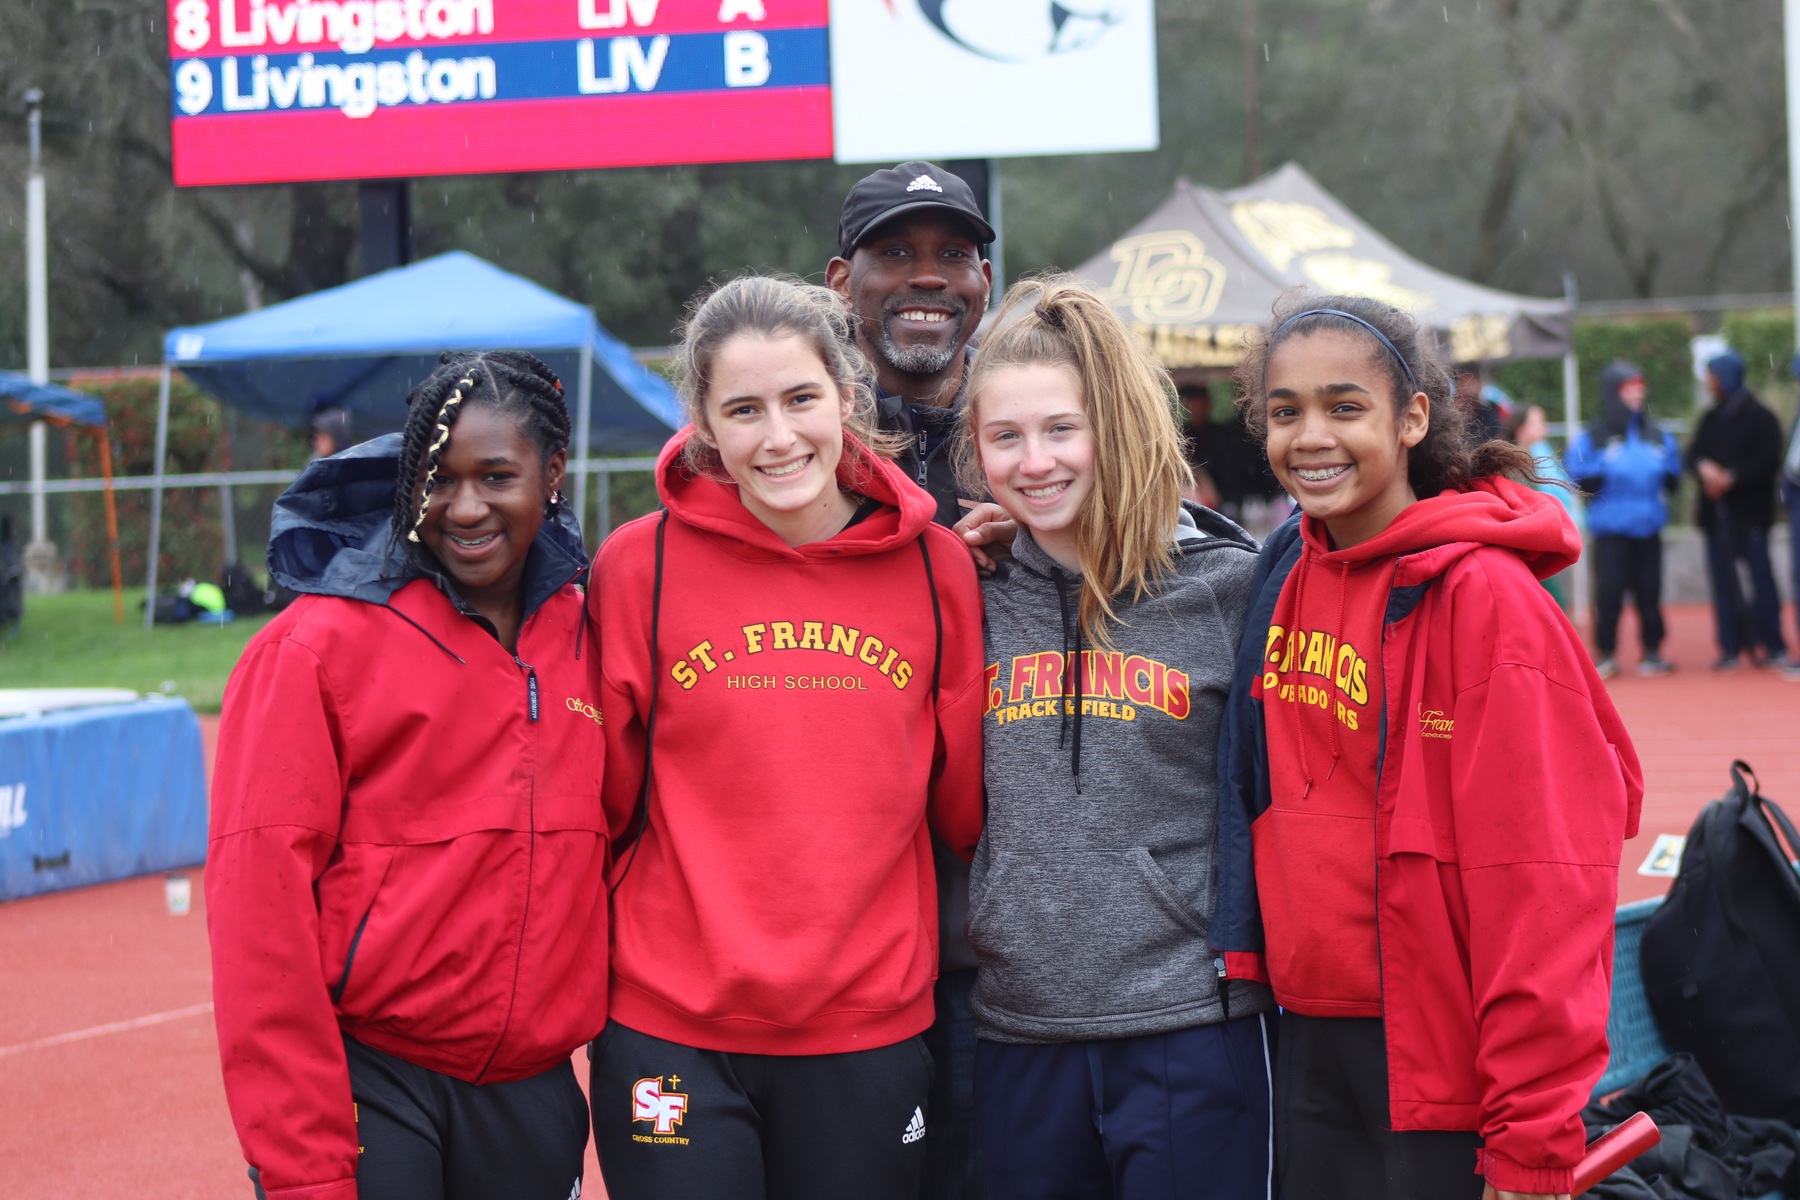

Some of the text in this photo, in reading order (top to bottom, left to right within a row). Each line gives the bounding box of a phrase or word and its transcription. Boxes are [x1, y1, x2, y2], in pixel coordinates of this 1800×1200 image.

[174, 0, 211, 50] 8
[219, 0, 494, 53] Livingston
[175, 30, 771, 118] 9 Livingston LIV B
[906, 183, 943, 193] adidas
[671, 621, 913, 690] ST. FRANCIS
[727, 675, 868, 690] HIGH SCHOOL
[1009, 650, 1191, 720] FRANCIS
[995, 700, 1059, 725] TRACK
[1081, 700, 1136, 721] FIELD
[632, 1075, 688, 1134] SF
[632, 1134, 690, 1145] CROSS COUNTRY
[902, 1126, 926, 1144] adidas
